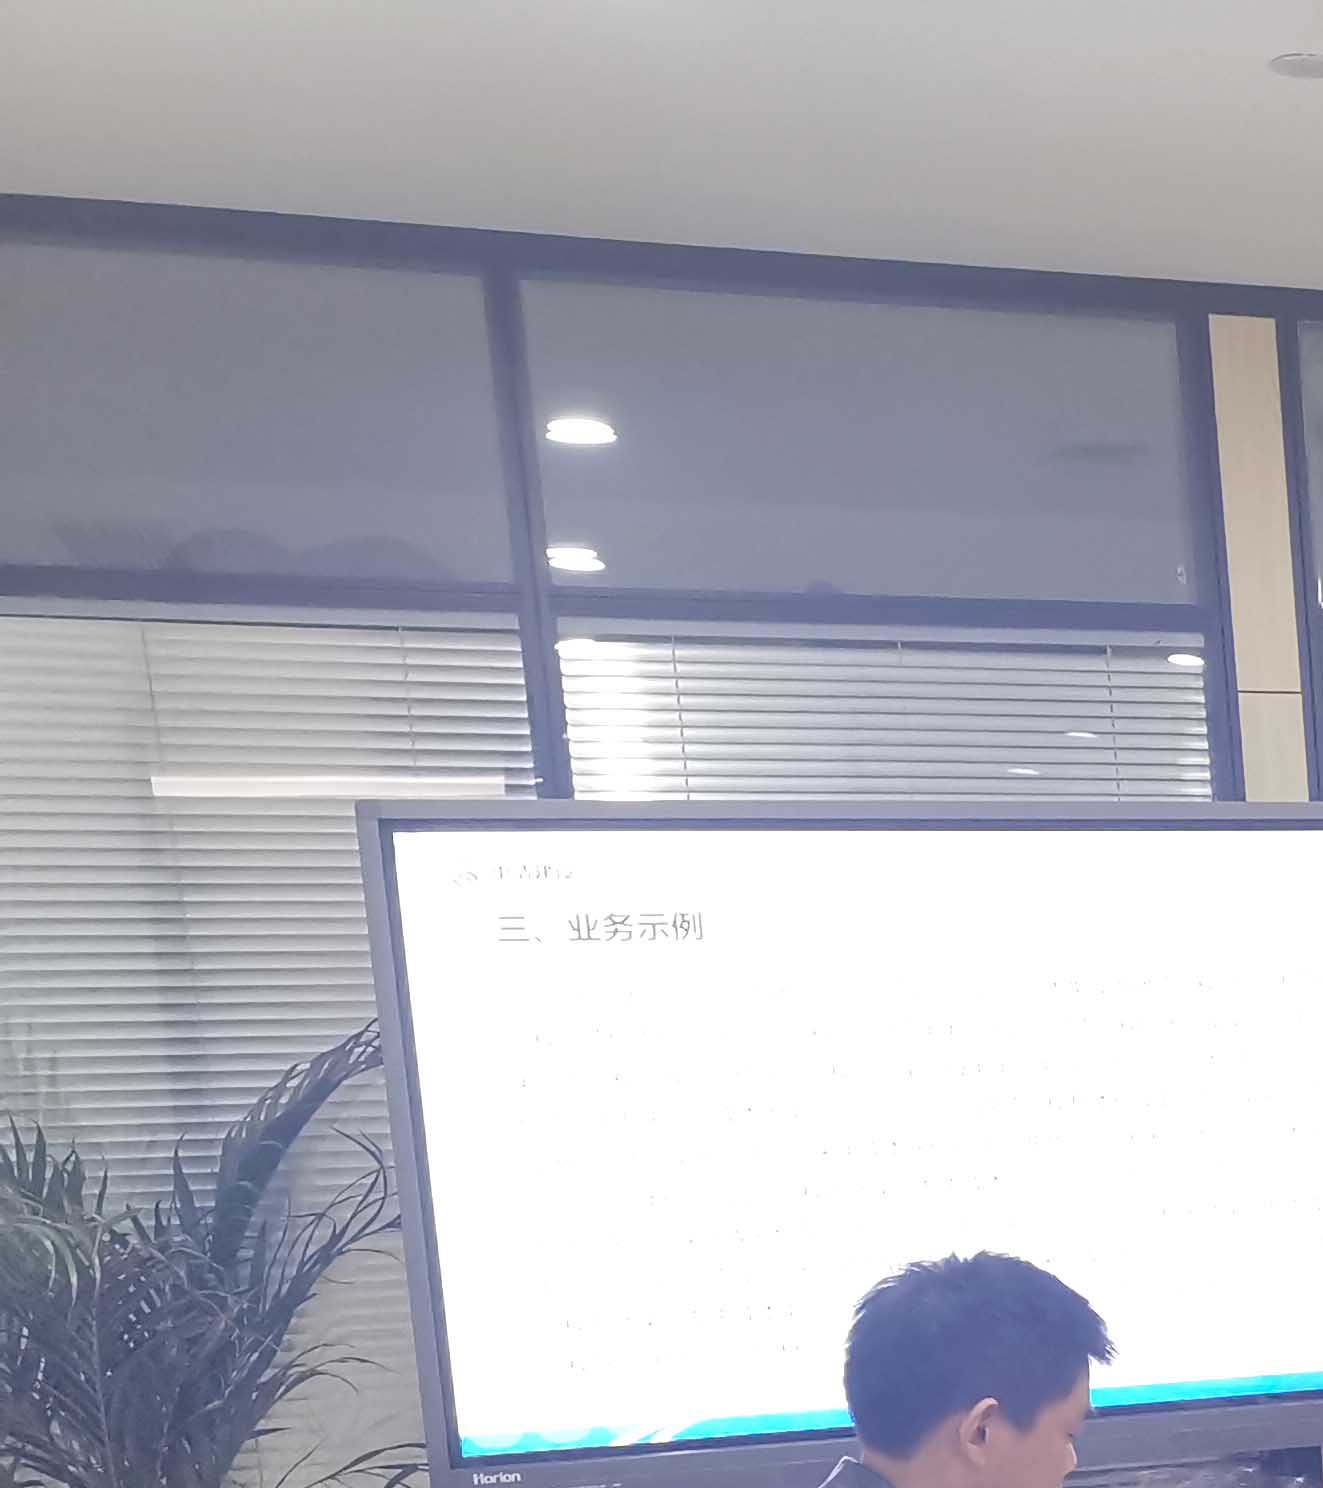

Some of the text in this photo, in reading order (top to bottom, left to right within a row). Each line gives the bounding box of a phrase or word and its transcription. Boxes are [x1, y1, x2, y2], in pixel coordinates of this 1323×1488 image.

[497, 911, 704, 943] 三、业务示例
